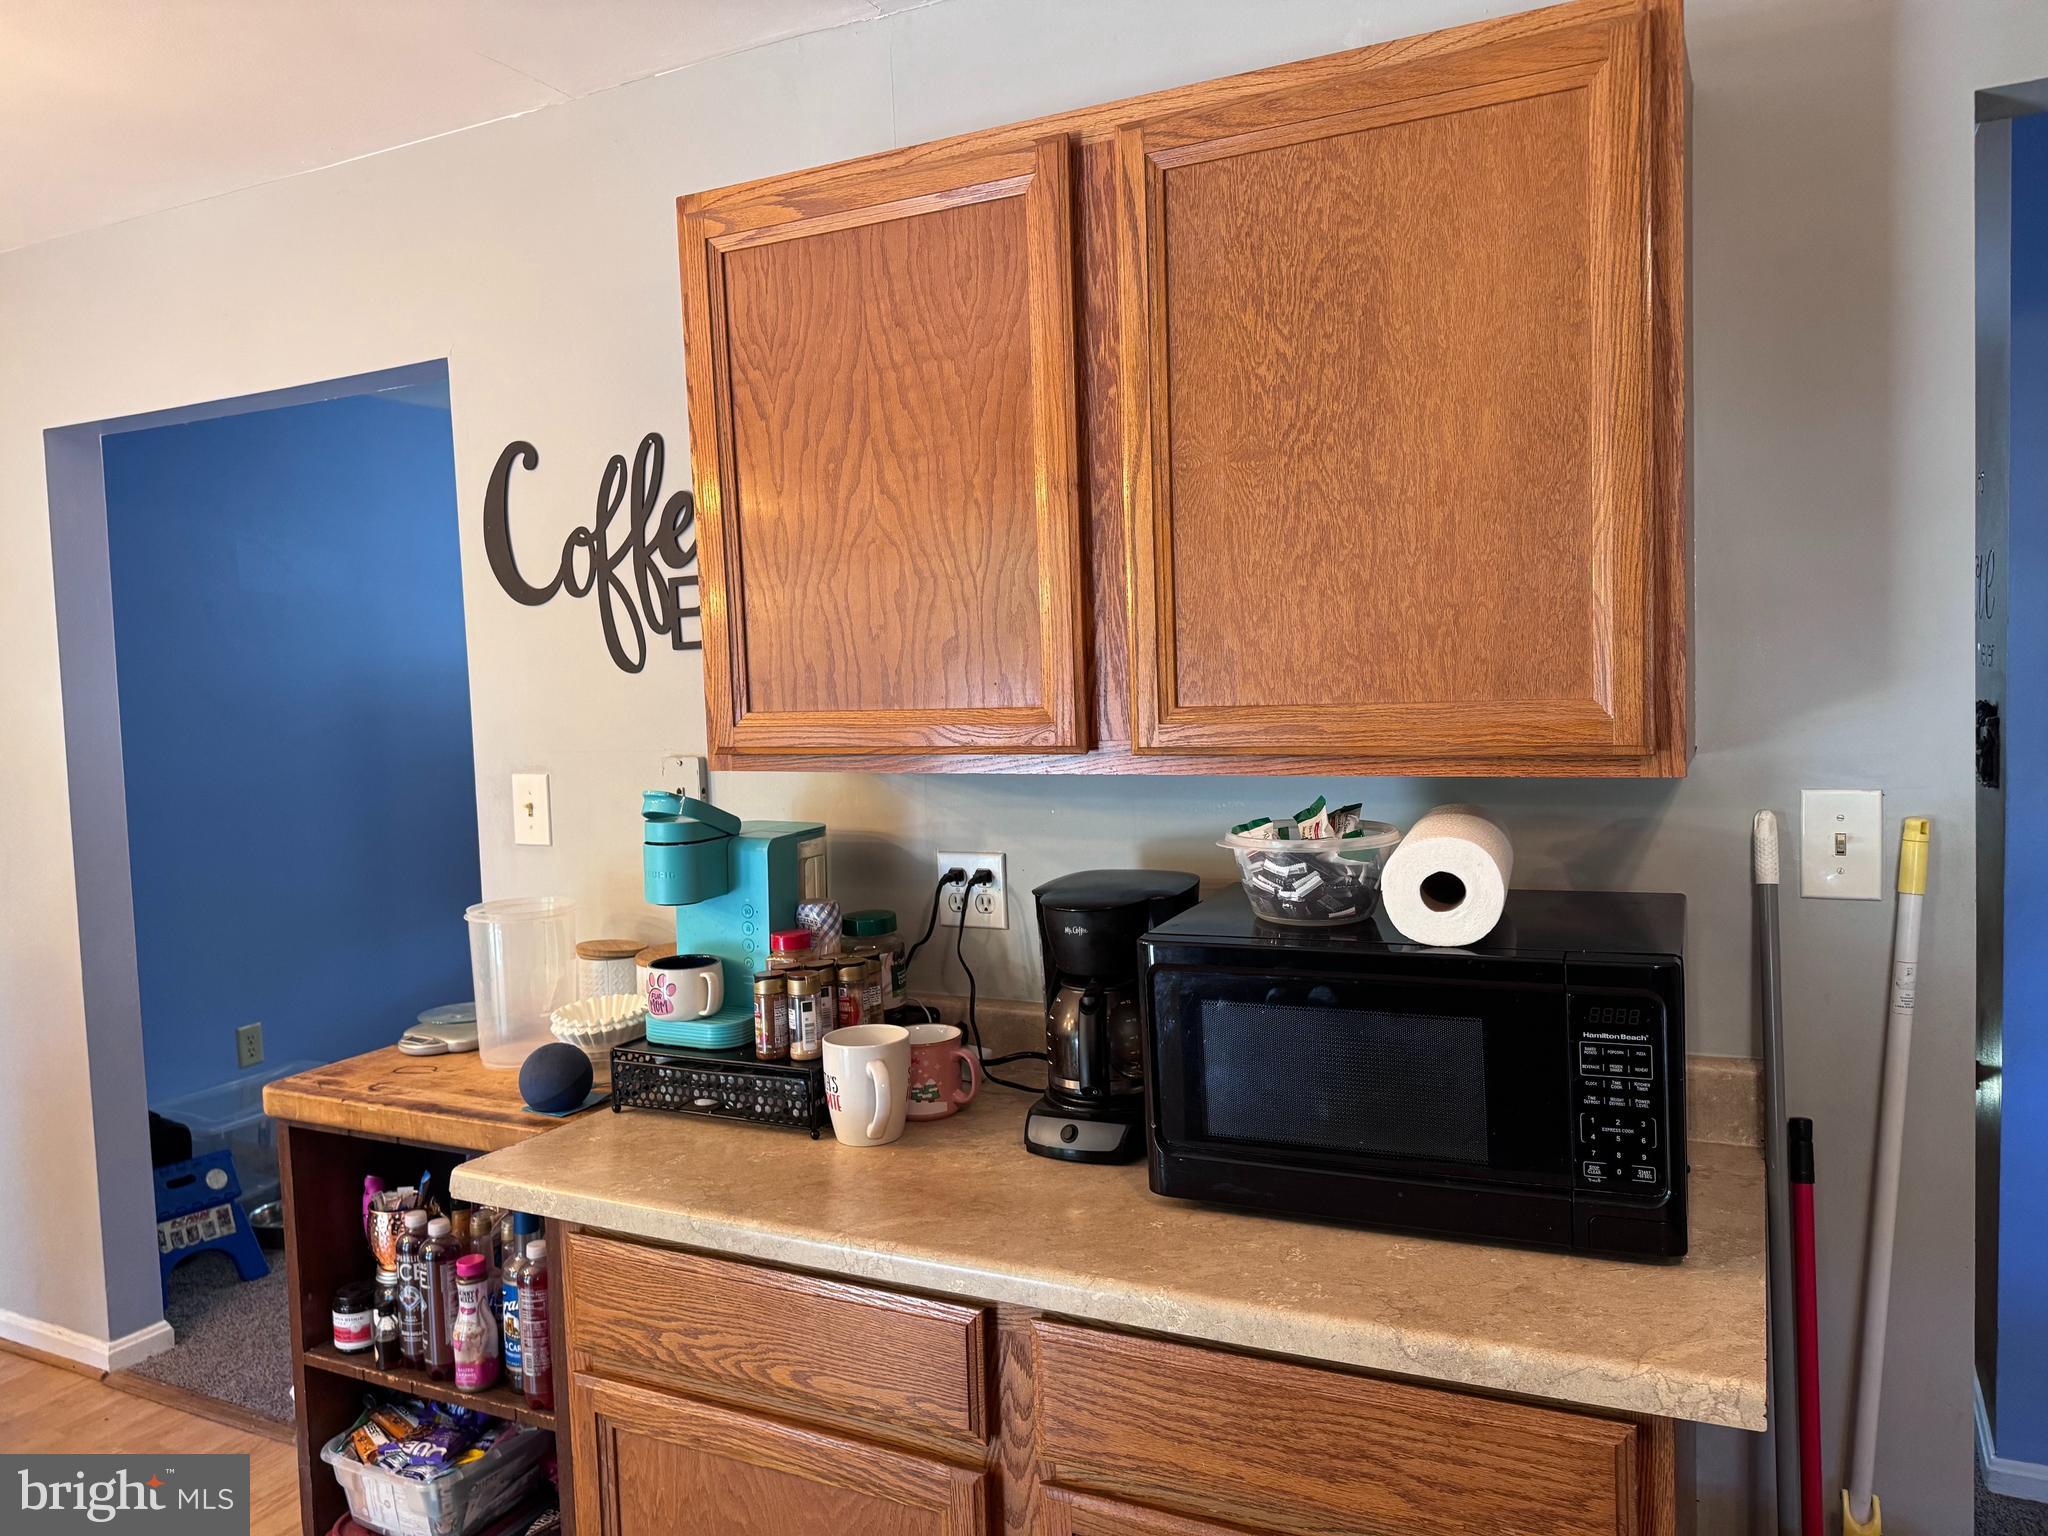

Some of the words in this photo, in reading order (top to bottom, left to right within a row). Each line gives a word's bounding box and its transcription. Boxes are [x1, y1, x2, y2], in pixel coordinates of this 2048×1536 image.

[483, 432, 697, 674] Coffe
[1582, 1031, 1620, 1040] Hamilton
[1620, 1033, 1647, 1041] Beach
[1641, 1120, 1646, 1128] 3
[1616, 1168, 1622, 1176] 0
